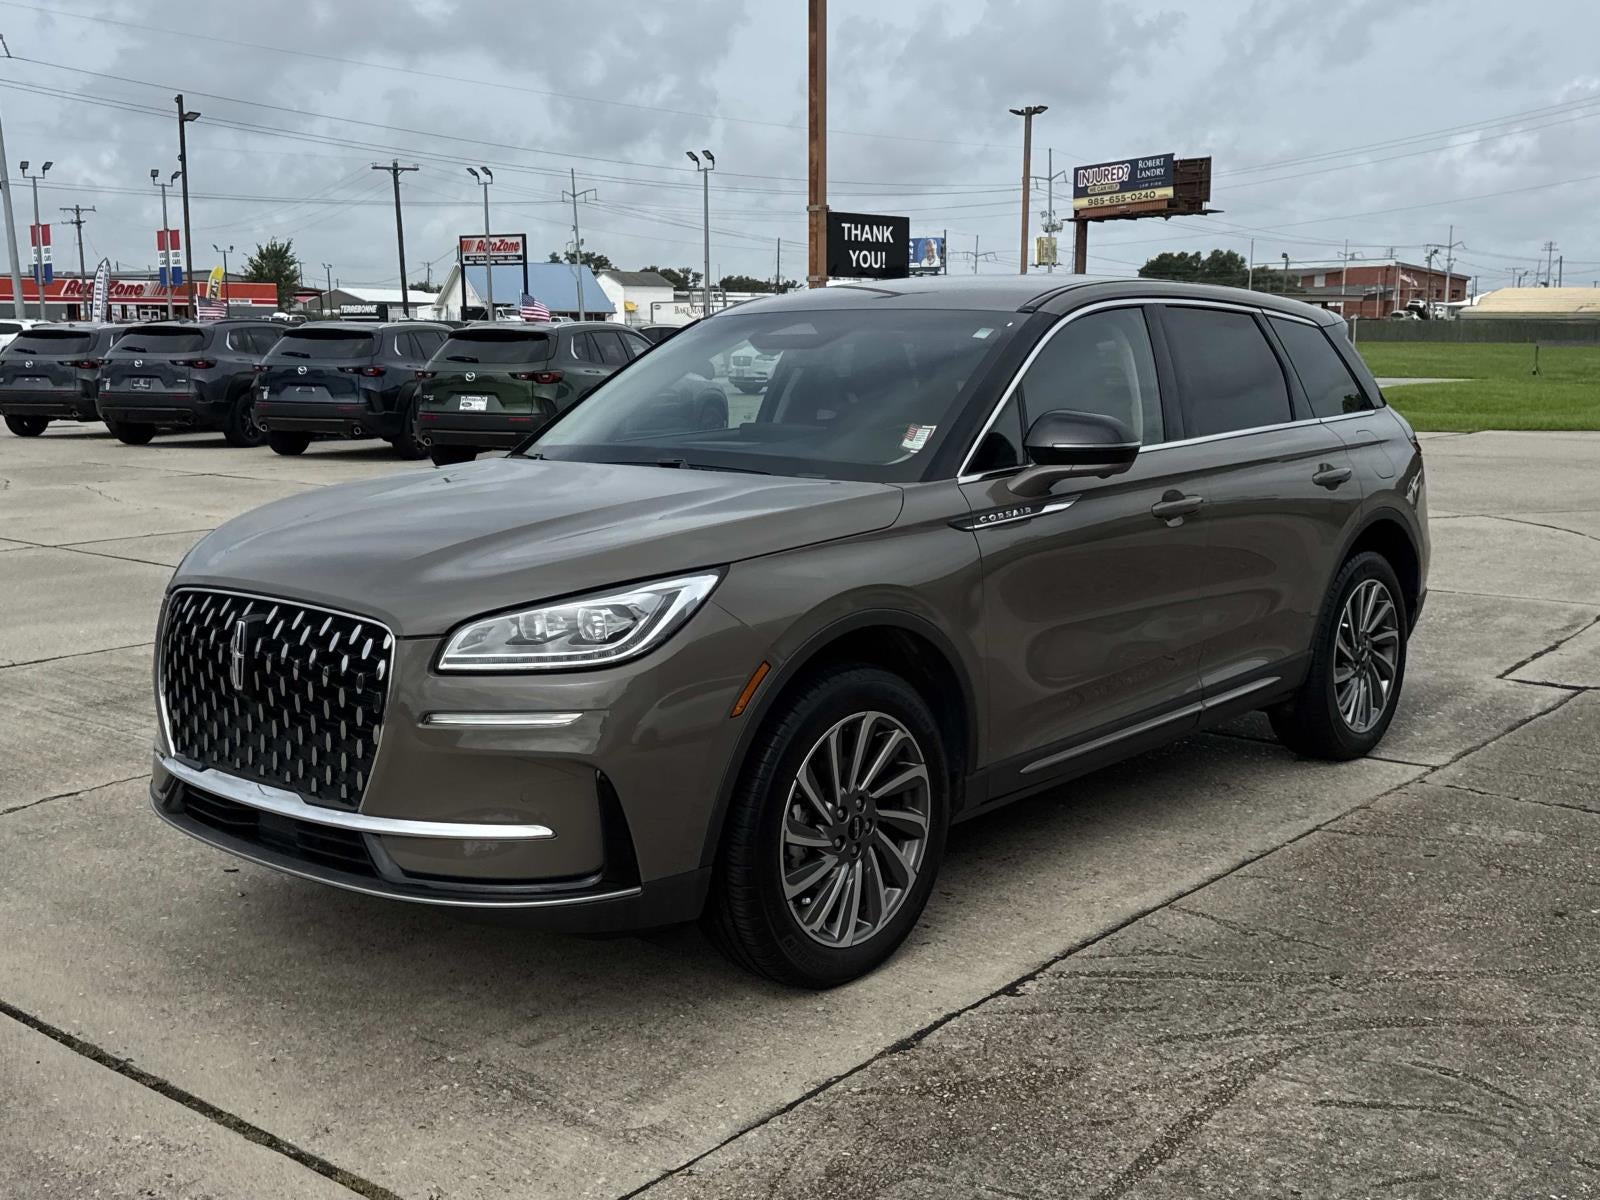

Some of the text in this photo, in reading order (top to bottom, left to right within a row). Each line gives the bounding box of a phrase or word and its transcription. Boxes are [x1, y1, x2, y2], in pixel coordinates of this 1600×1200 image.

[1138, 157, 1165, 169] ROBERT
[1077, 163, 1131, 188] INJURED?
[1137, 167, 1166, 179] LANDRY
[1087, 190, 1156, 206] 985-655-0240
[841, 223, 894, 244] THANK
[848, 249, 886, 269] YOU!
[63, 279, 145, 297] AutZone
[979, 506, 1032, 524] CORSAIR
